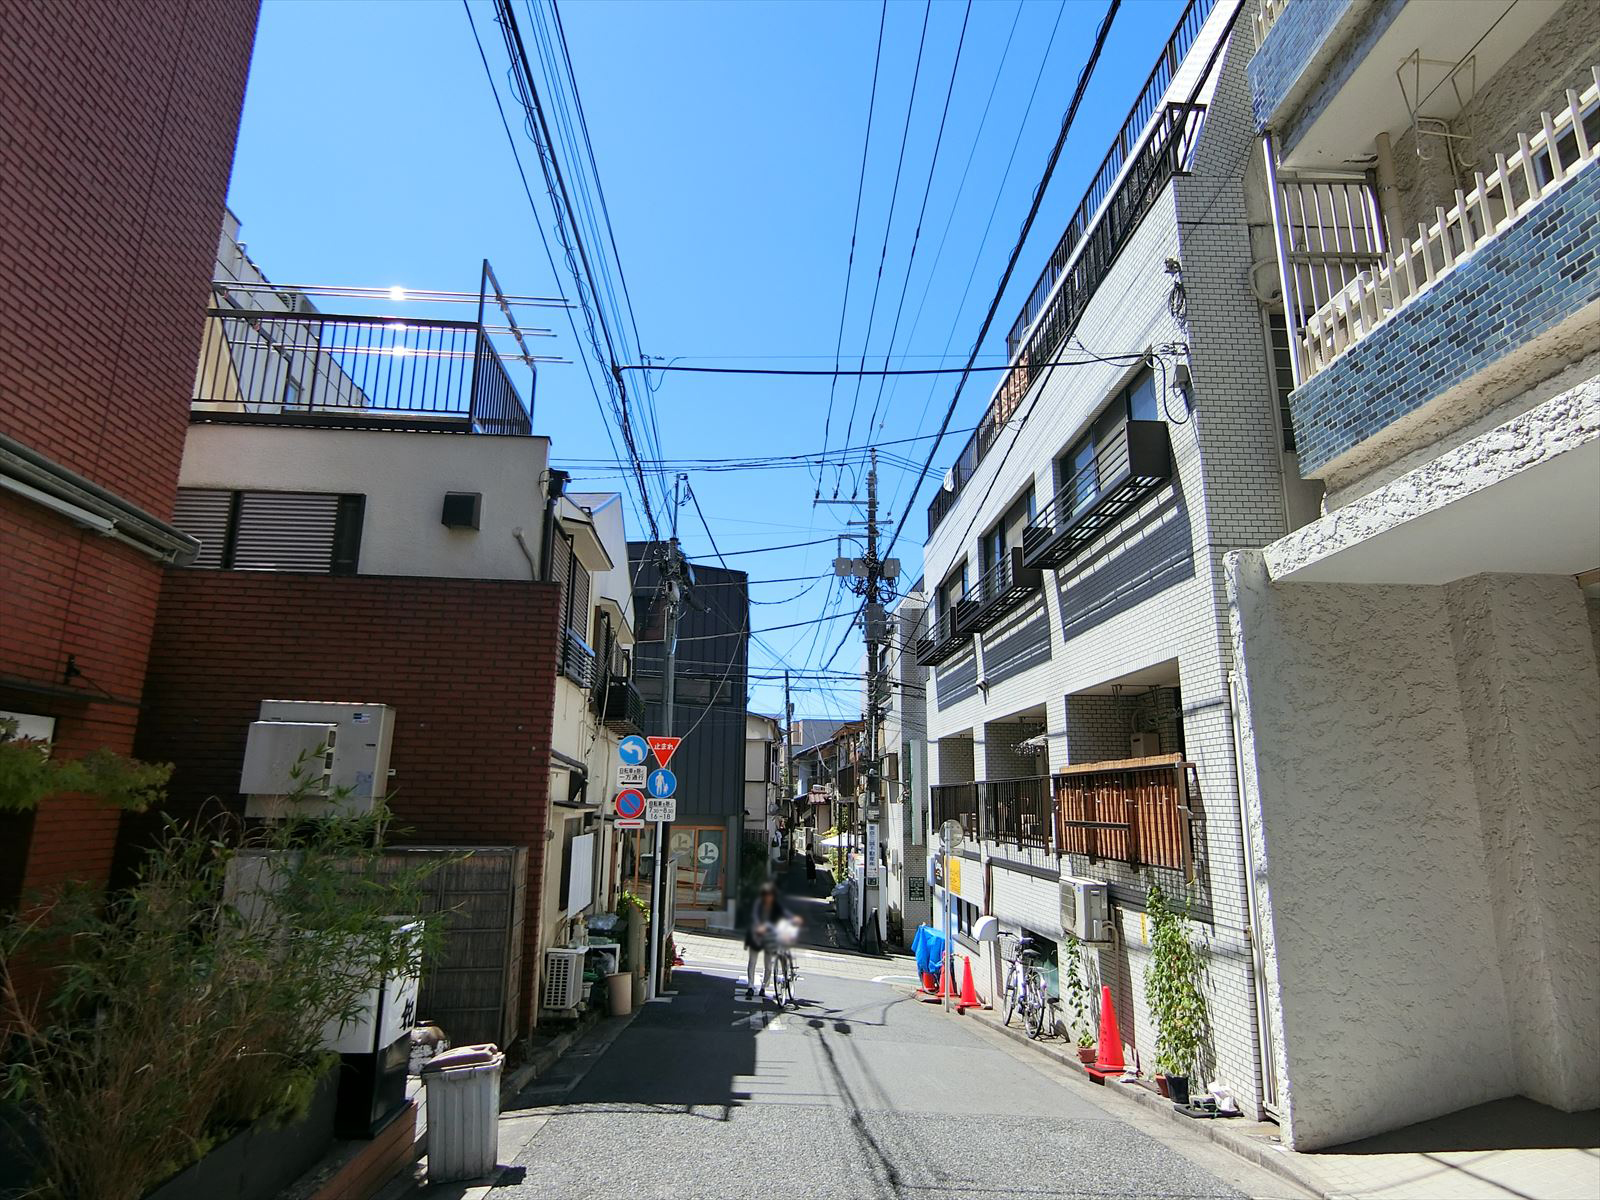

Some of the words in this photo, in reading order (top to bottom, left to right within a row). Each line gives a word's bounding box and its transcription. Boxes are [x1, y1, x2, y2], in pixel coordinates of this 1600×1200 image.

[654, 742, 674, 750] 止まれ
[699, 843, 716, 860] 上
